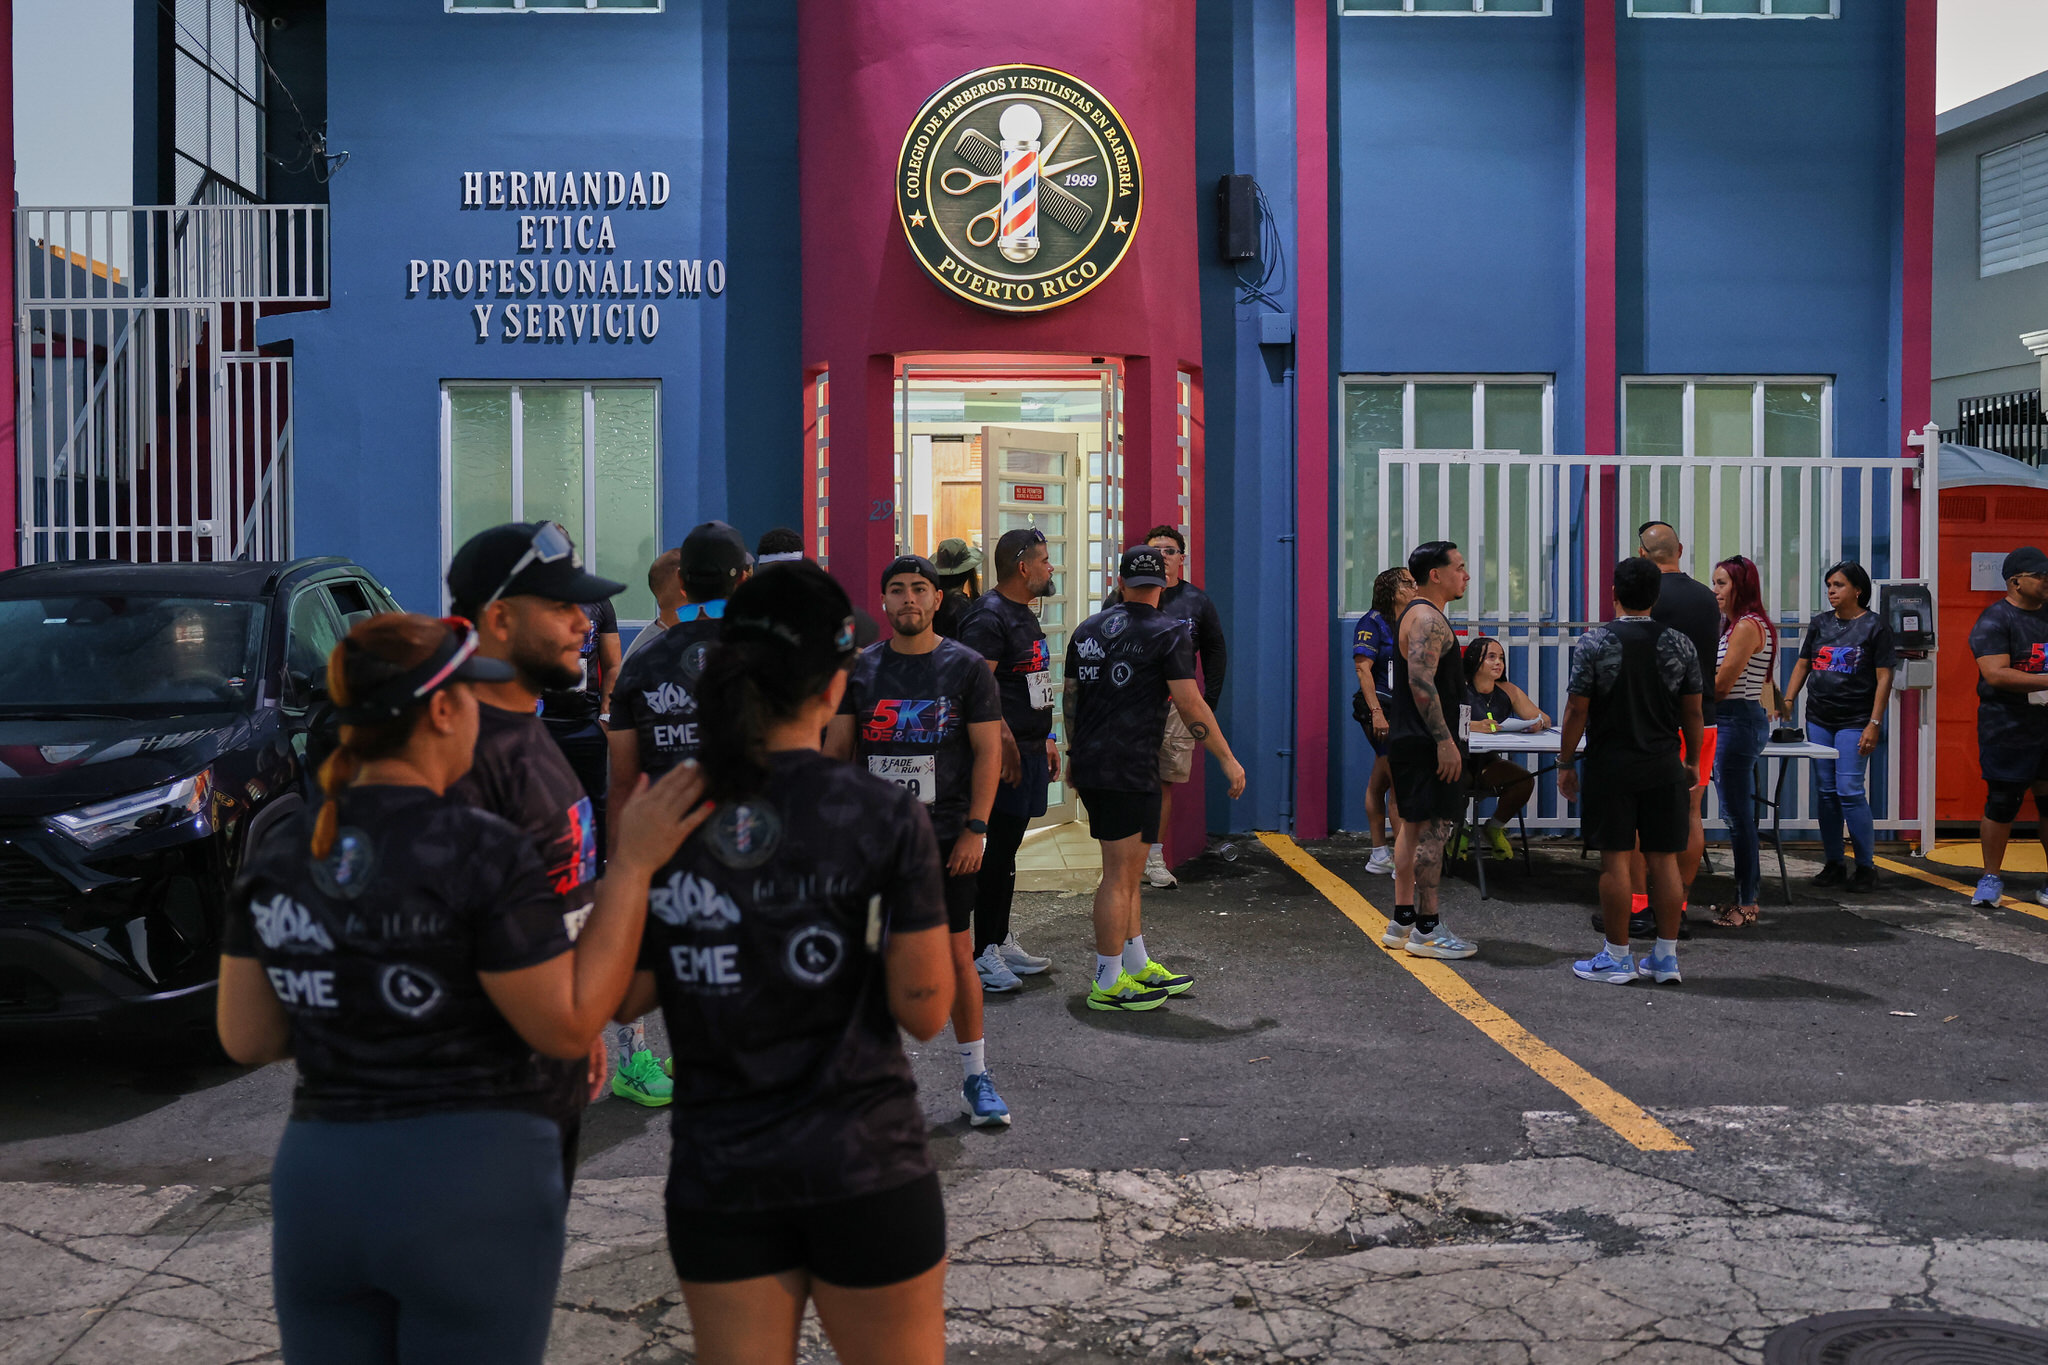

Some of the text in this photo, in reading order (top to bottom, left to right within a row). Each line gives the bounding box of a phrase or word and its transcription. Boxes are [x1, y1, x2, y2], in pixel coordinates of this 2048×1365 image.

[906, 76, 1131, 198] COLEGIO DE BARBEROS Y ESTILISTAS EN BARBERÍA
[463, 171, 671, 205] HERMANDAD
[1063, 174, 1098, 187] 1989
[520, 215, 617, 249] ETICA
[409, 259, 726, 294] PROFESIONALISMO
[937, 255, 1098, 301] PUERTO RICO
[474, 303, 660, 338] Y SERVICIO
[869, 500, 894, 521] 29
[1357, 630, 1373, 641] TF
[1816, 646, 1854, 665] 5K
[1078, 666, 1100, 680] EME
[1042, 688, 1054, 703] 12
[869, 699, 936, 730] 5K
[653, 723, 700, 746] EME
[863, 729, 894, 742] ADE
[893, 730, 905, 743] &
[889, 758, 913, 767] FADE
[901, 766, 921, 774] RUN
[670, 944, 742, 984] EME
[267, 967, 339, 1008] EME
